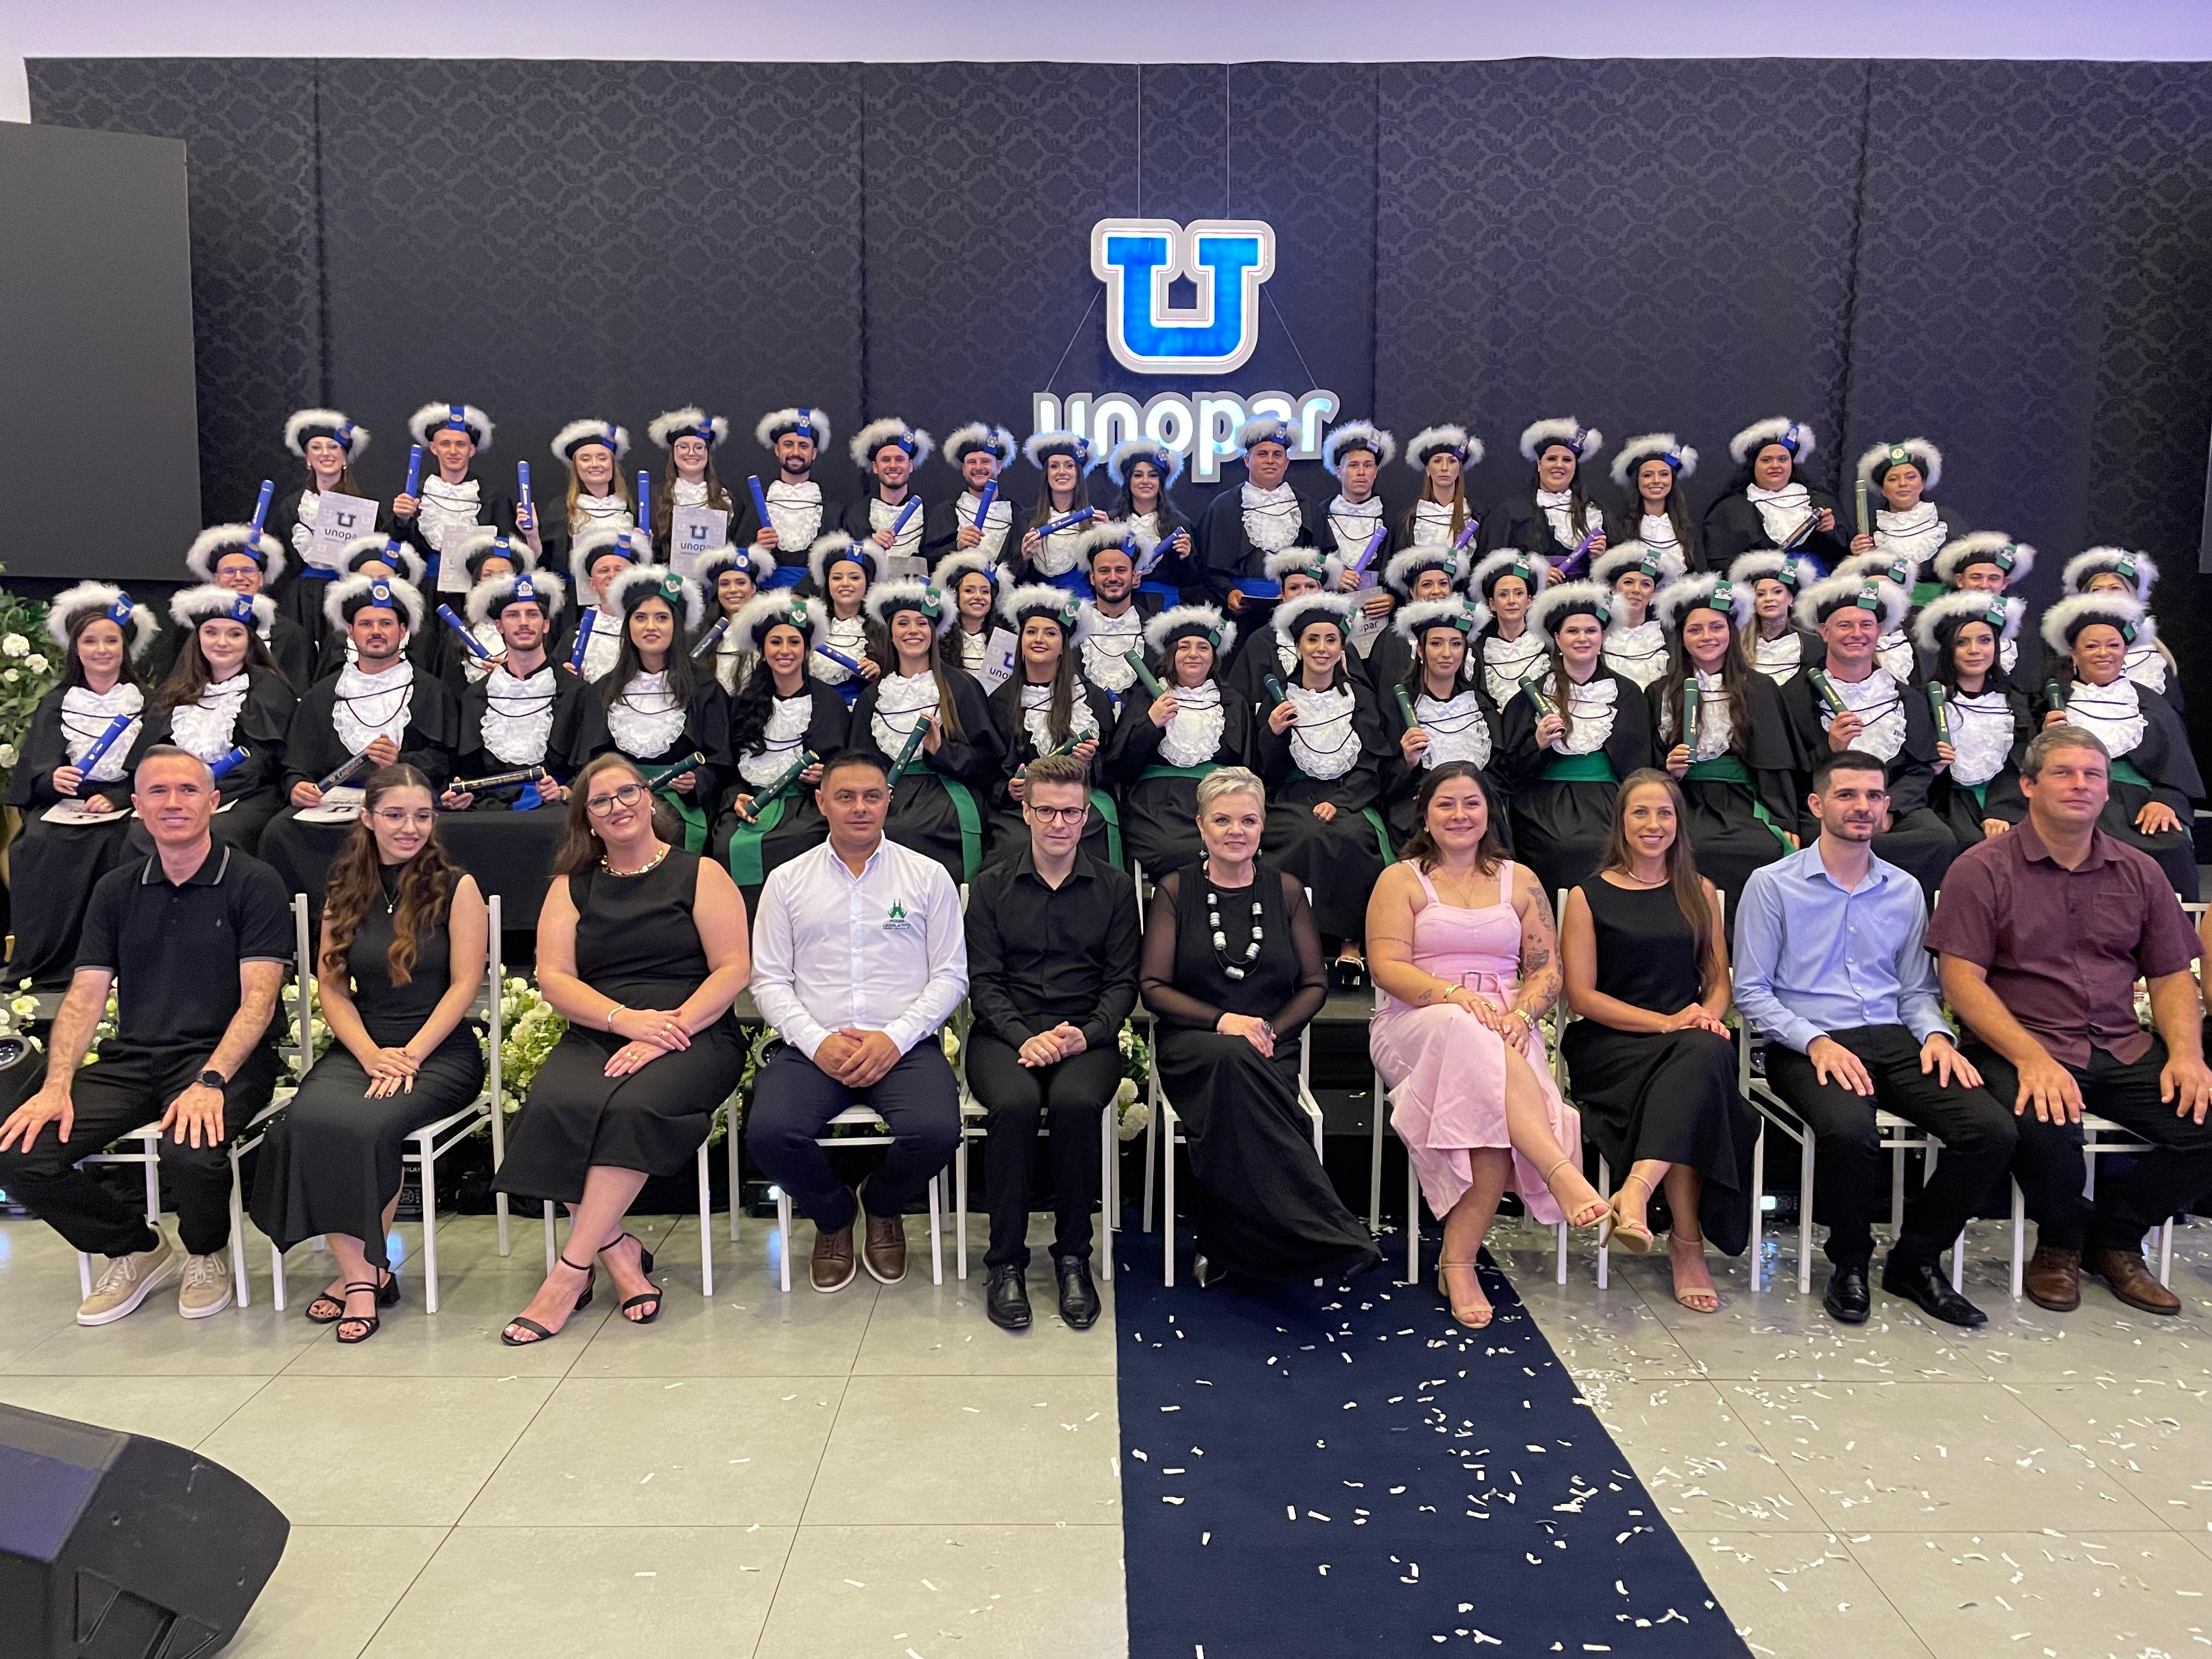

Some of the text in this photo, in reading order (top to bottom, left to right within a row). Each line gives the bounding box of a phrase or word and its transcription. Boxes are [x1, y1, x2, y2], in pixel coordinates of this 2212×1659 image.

[1102, 231, 1265, 363] U
[325, 528, 357, 541] unopa
[1363, 621, 1378, 632] par
[990, 667, 1008, 679] uno
